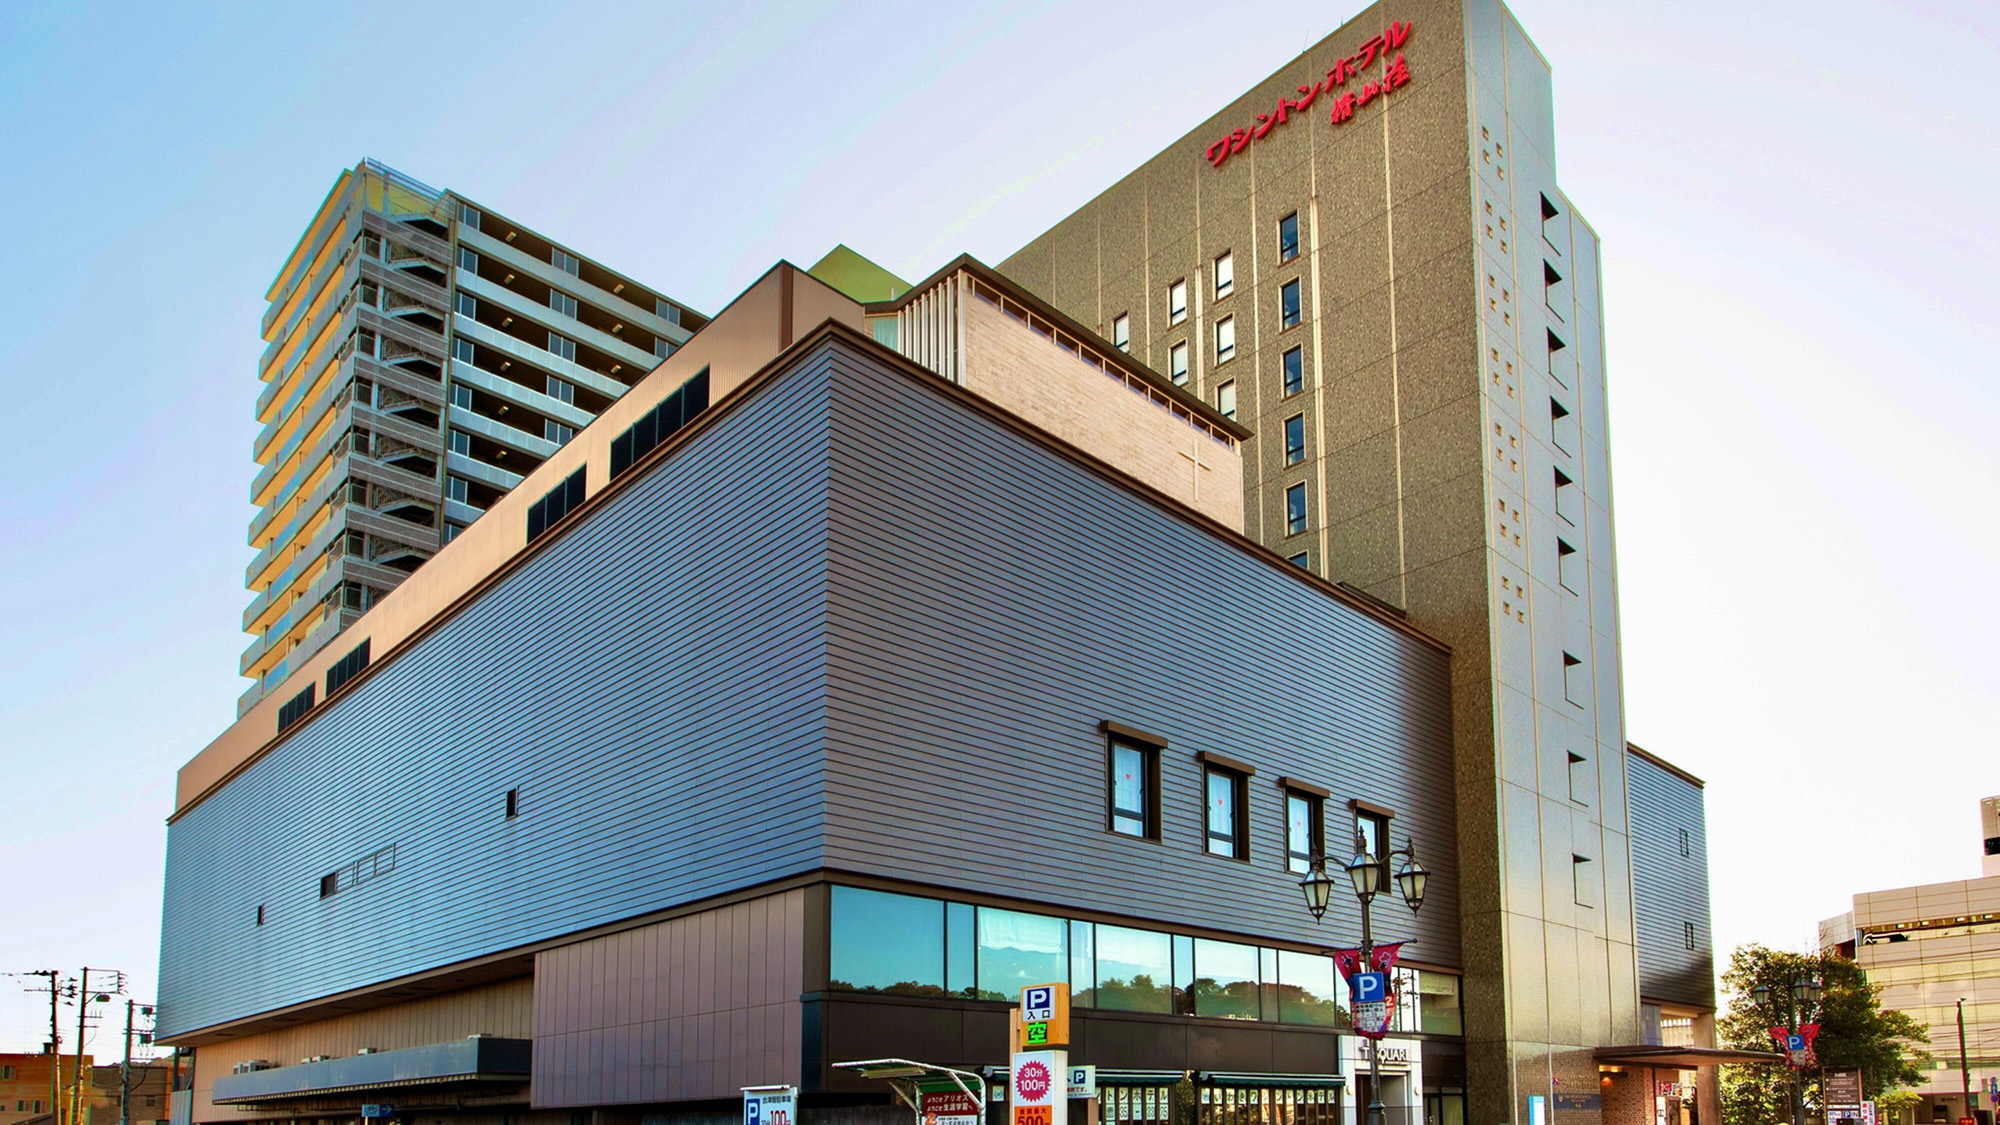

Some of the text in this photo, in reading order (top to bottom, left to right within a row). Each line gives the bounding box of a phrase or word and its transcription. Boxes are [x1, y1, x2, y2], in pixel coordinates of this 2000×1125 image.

[1206, 20, 1412, 168] ワシントンホテル
[1359, 975, 1378, 1000] P
[1030, 990, 1047, 1009] P
[1027, 1010, 1051, 1020] 入口
[1027, 1021, 1047, 1044] 空
[1788, 1036, 1800, 1049] P
[1024, 1067, 1043, 1078] 30分
[1075, 1071, 1084, 1083] P
[1020, 1080, 1046, 1091] 100円
[747, 1102, 759, 1125] P
